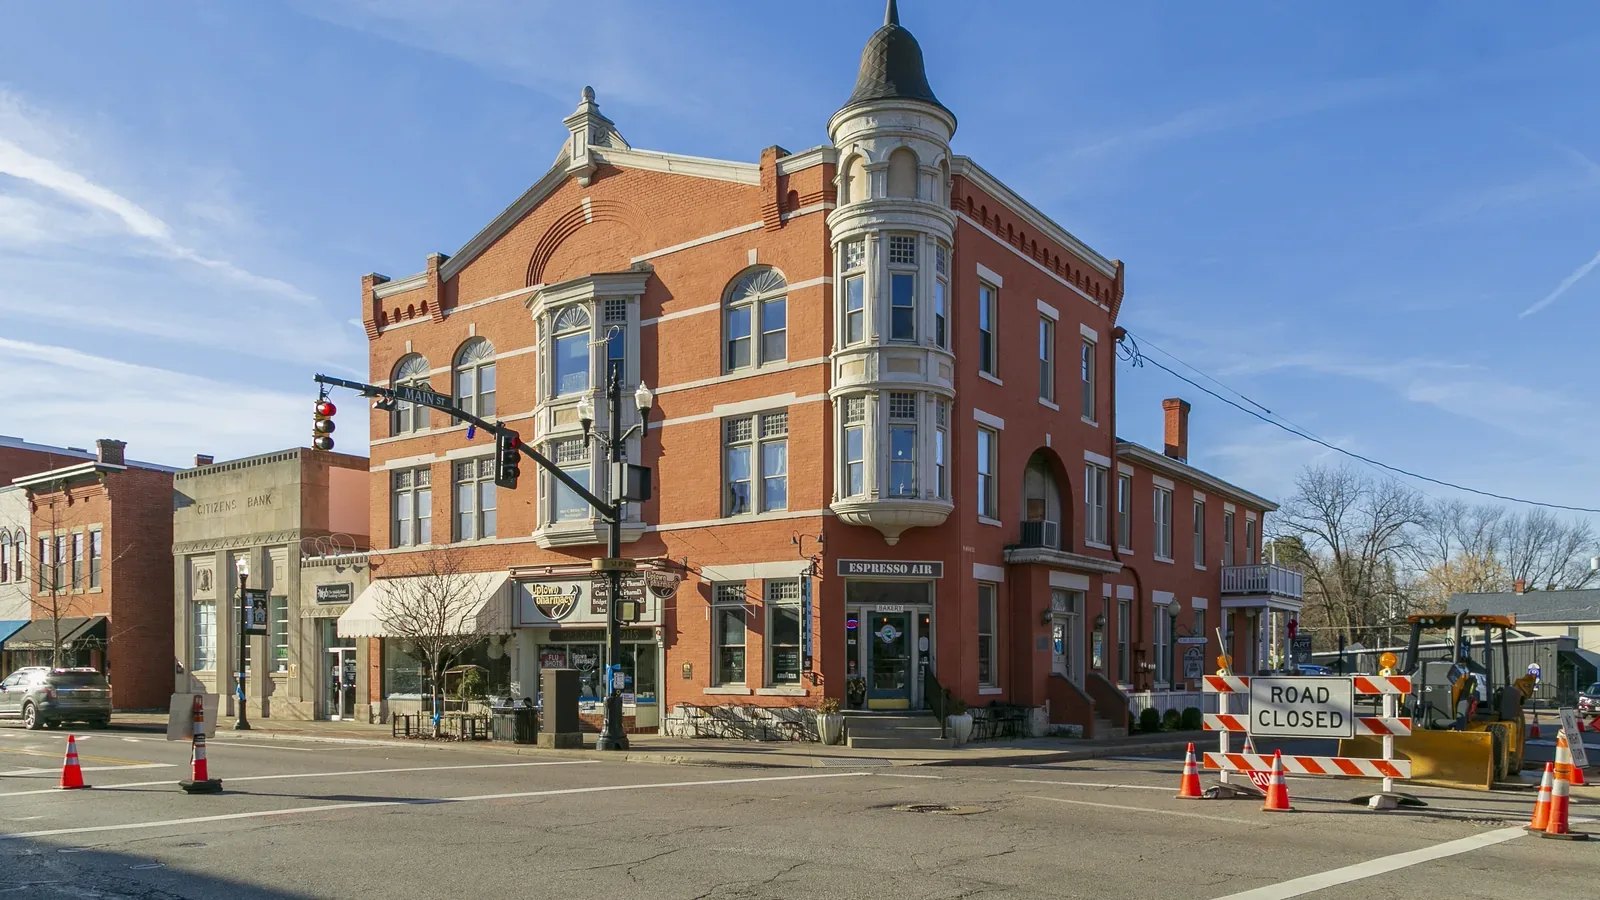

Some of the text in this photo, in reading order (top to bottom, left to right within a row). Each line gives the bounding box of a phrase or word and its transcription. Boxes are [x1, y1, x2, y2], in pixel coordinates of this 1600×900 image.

[404, 388, 446, 406] MAIN ST
[197, 494, 272, 515] CITIZENS BANK
[646, 571, 666, 581] Uptown
[849, 563, 932, 574] ESPRESSO AIR
[532, 583, 560, 595] Uptown
[536, 595, 574, 605] pharmacy
[1271, 686, 1330, 704] ROAD
[1259, 710, 1343, 728] CLOSED
